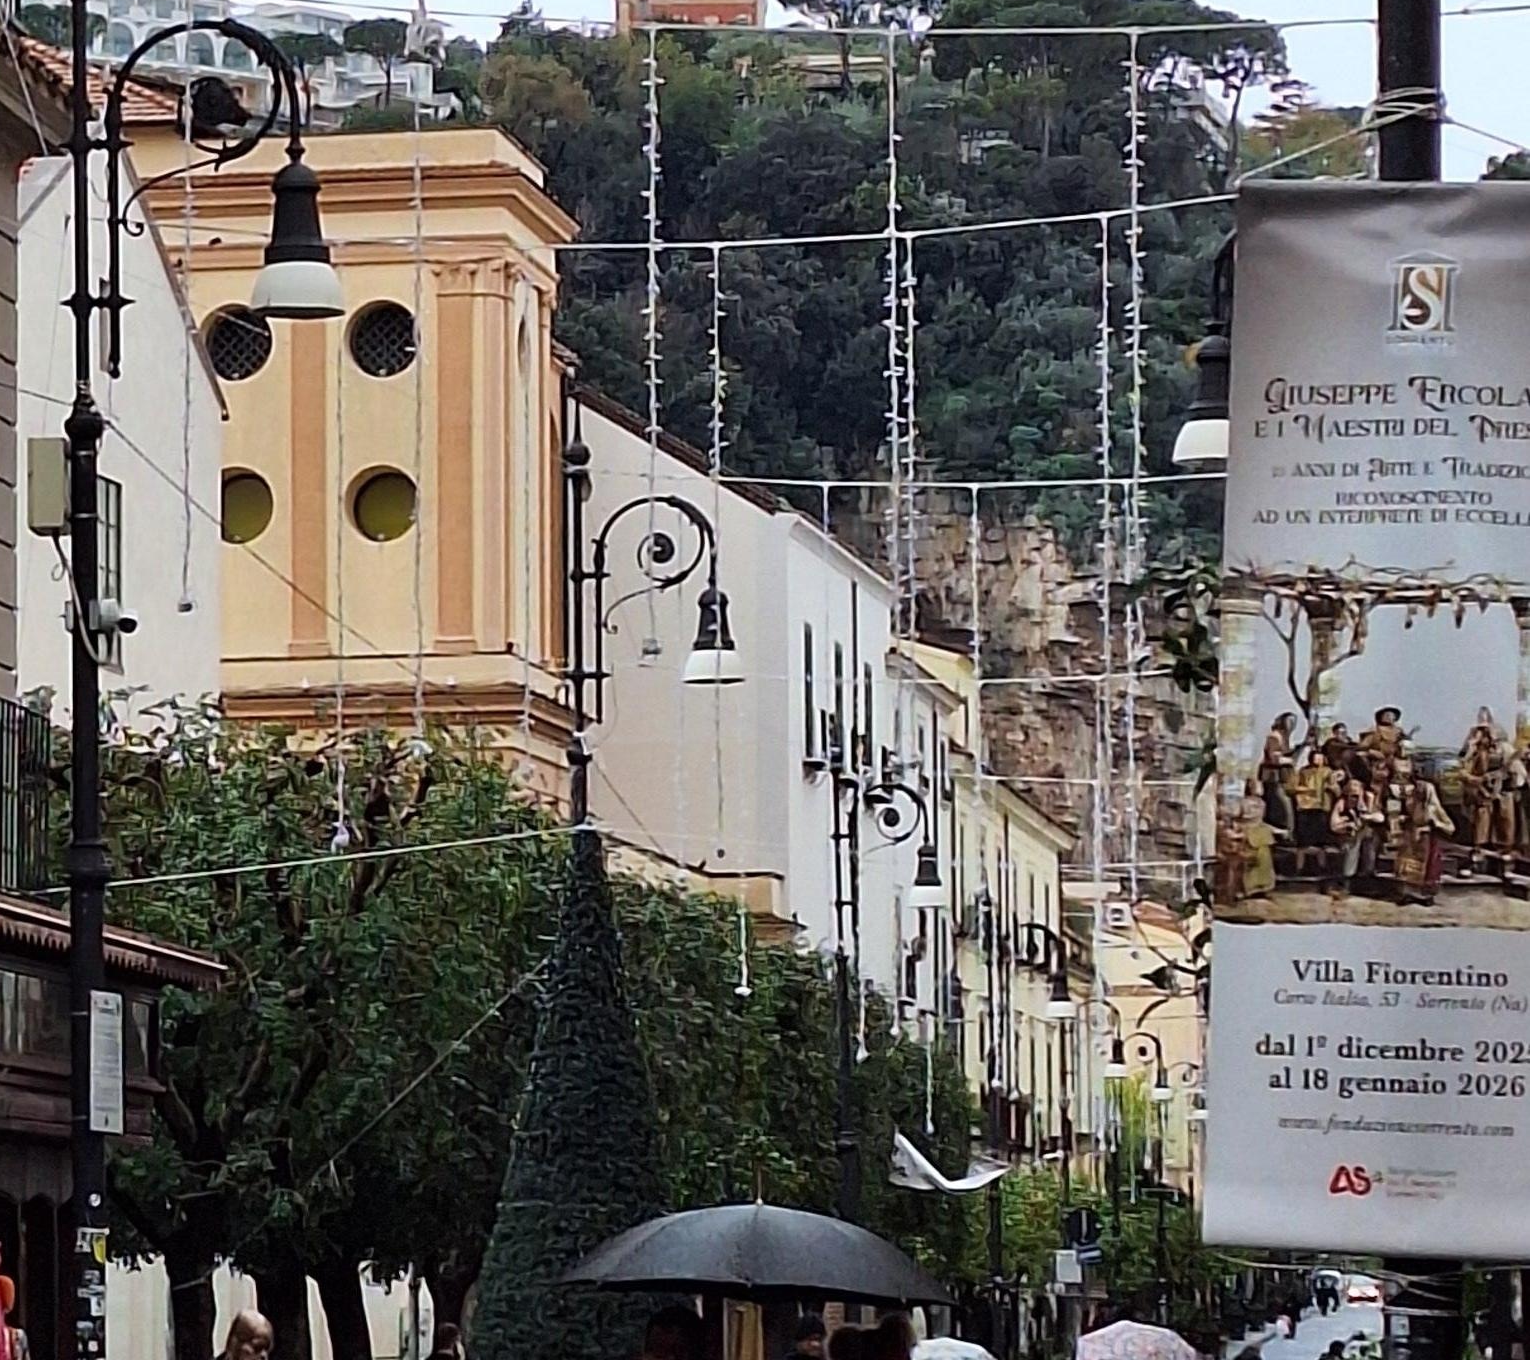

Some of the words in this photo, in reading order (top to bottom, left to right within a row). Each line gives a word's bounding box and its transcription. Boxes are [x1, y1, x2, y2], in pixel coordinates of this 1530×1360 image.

[1264, 377, 1397, 415] GIUSEPPE
[1254, 421, 1269, 437] E
[1277, 421, 1284, 437] I
[1292, 414, 1404, 443] MAESTRI
[1413, 418, 1458, 436] DEL
[1468, 414, 1530, 443] PRE
[1342, 462, 1359, 477] DI
[1368, 457, 1418, 482] ARTE
[1335, 490, 1493, 506] RICONOSCIMENTO
[1252, 509, 1279, 524] AD
[1285, 509, 1311, 524] UN
[1319, 509, 1424, 525] INTERPRETE
[1430, 508, 1447, 523] DI
[1455, 508, 1530, 527] ECCELL
[1292, 959, 1354, 983] Villa
[1365, 961, 1509, 988] Fiorentino
[1273, 989, 1317, 1006] Corso
[1415, 993, 1487, 1011] Sorrento
[1491, 993, 1528, 1014] (Na)
[1255, 1033, 1295, 1057] dal
[1337, 1036, 1465, 1062] dicembre
[1475, 1040, 1530, 1064] 202
[1269, 1066, 1292, 1089] al
[1302, 1068, 1329, 1091] 18
[1338, 1072, 1447, 1099] gennaio
[1458, 1072, 1526, 1098] 2026
